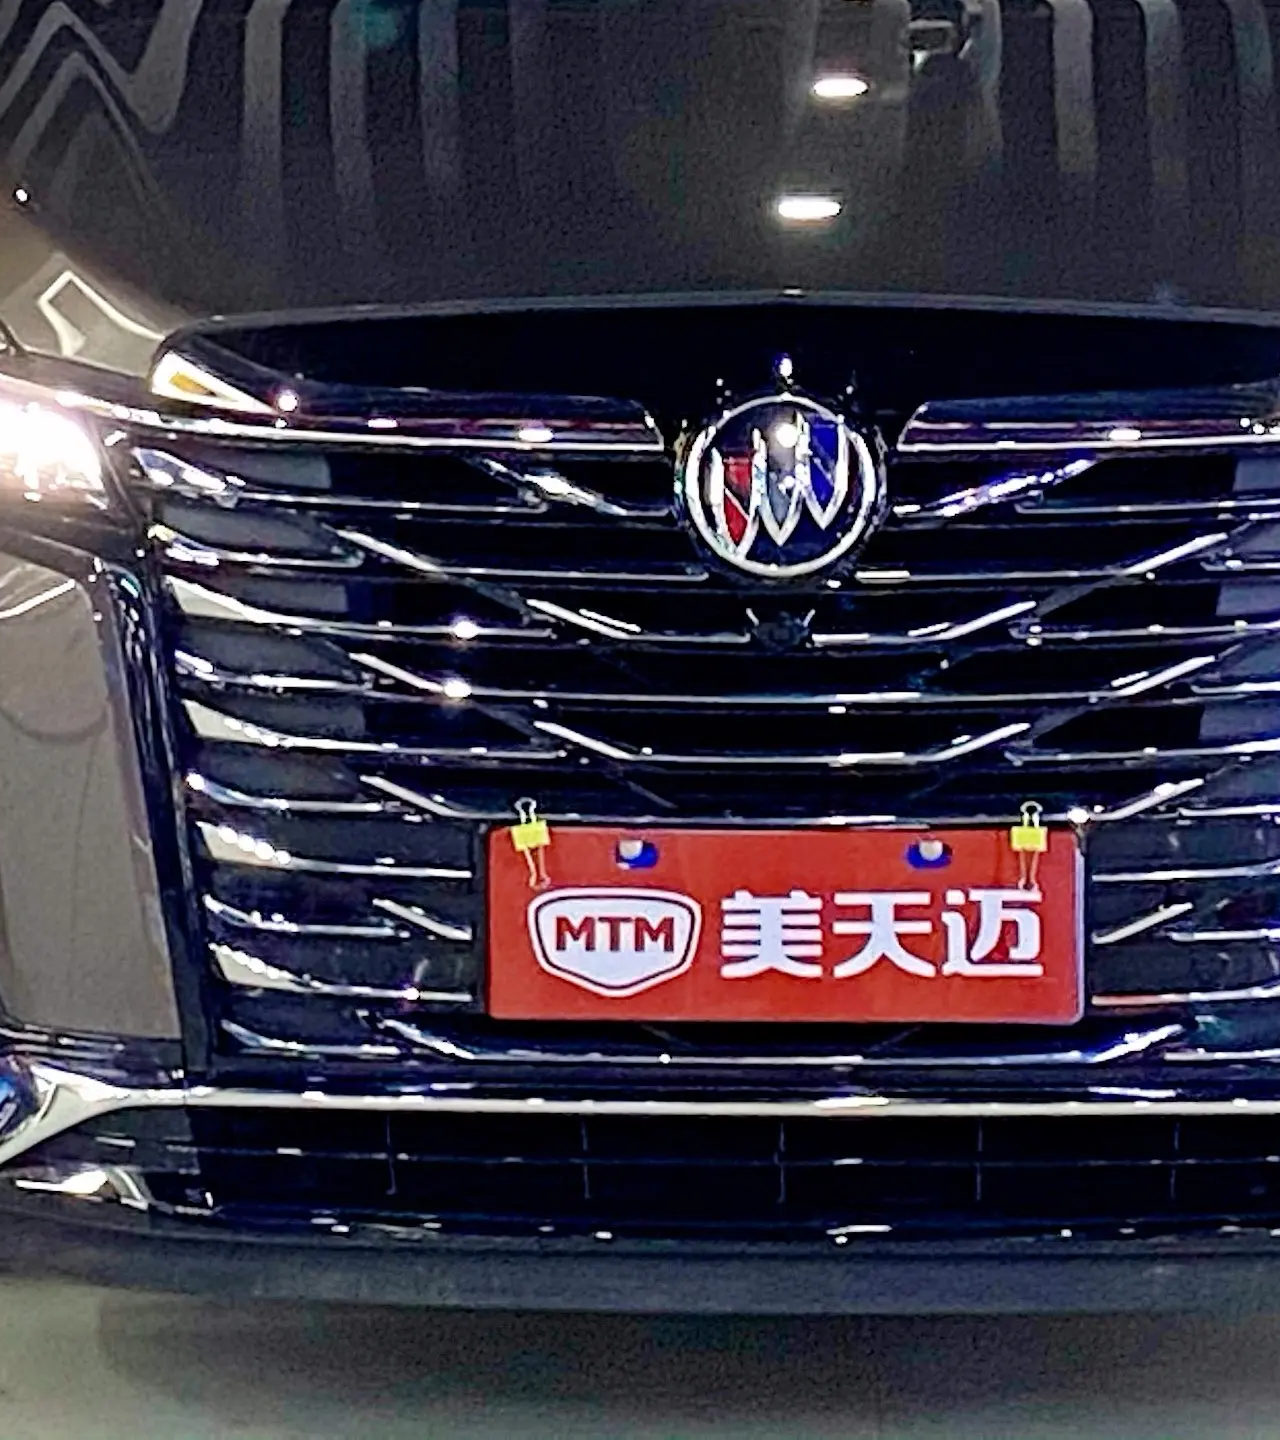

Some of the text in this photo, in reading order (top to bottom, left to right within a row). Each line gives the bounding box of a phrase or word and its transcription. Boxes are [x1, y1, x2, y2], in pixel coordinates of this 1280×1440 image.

[555, 888, 1044, 978] MTM 美天迈
